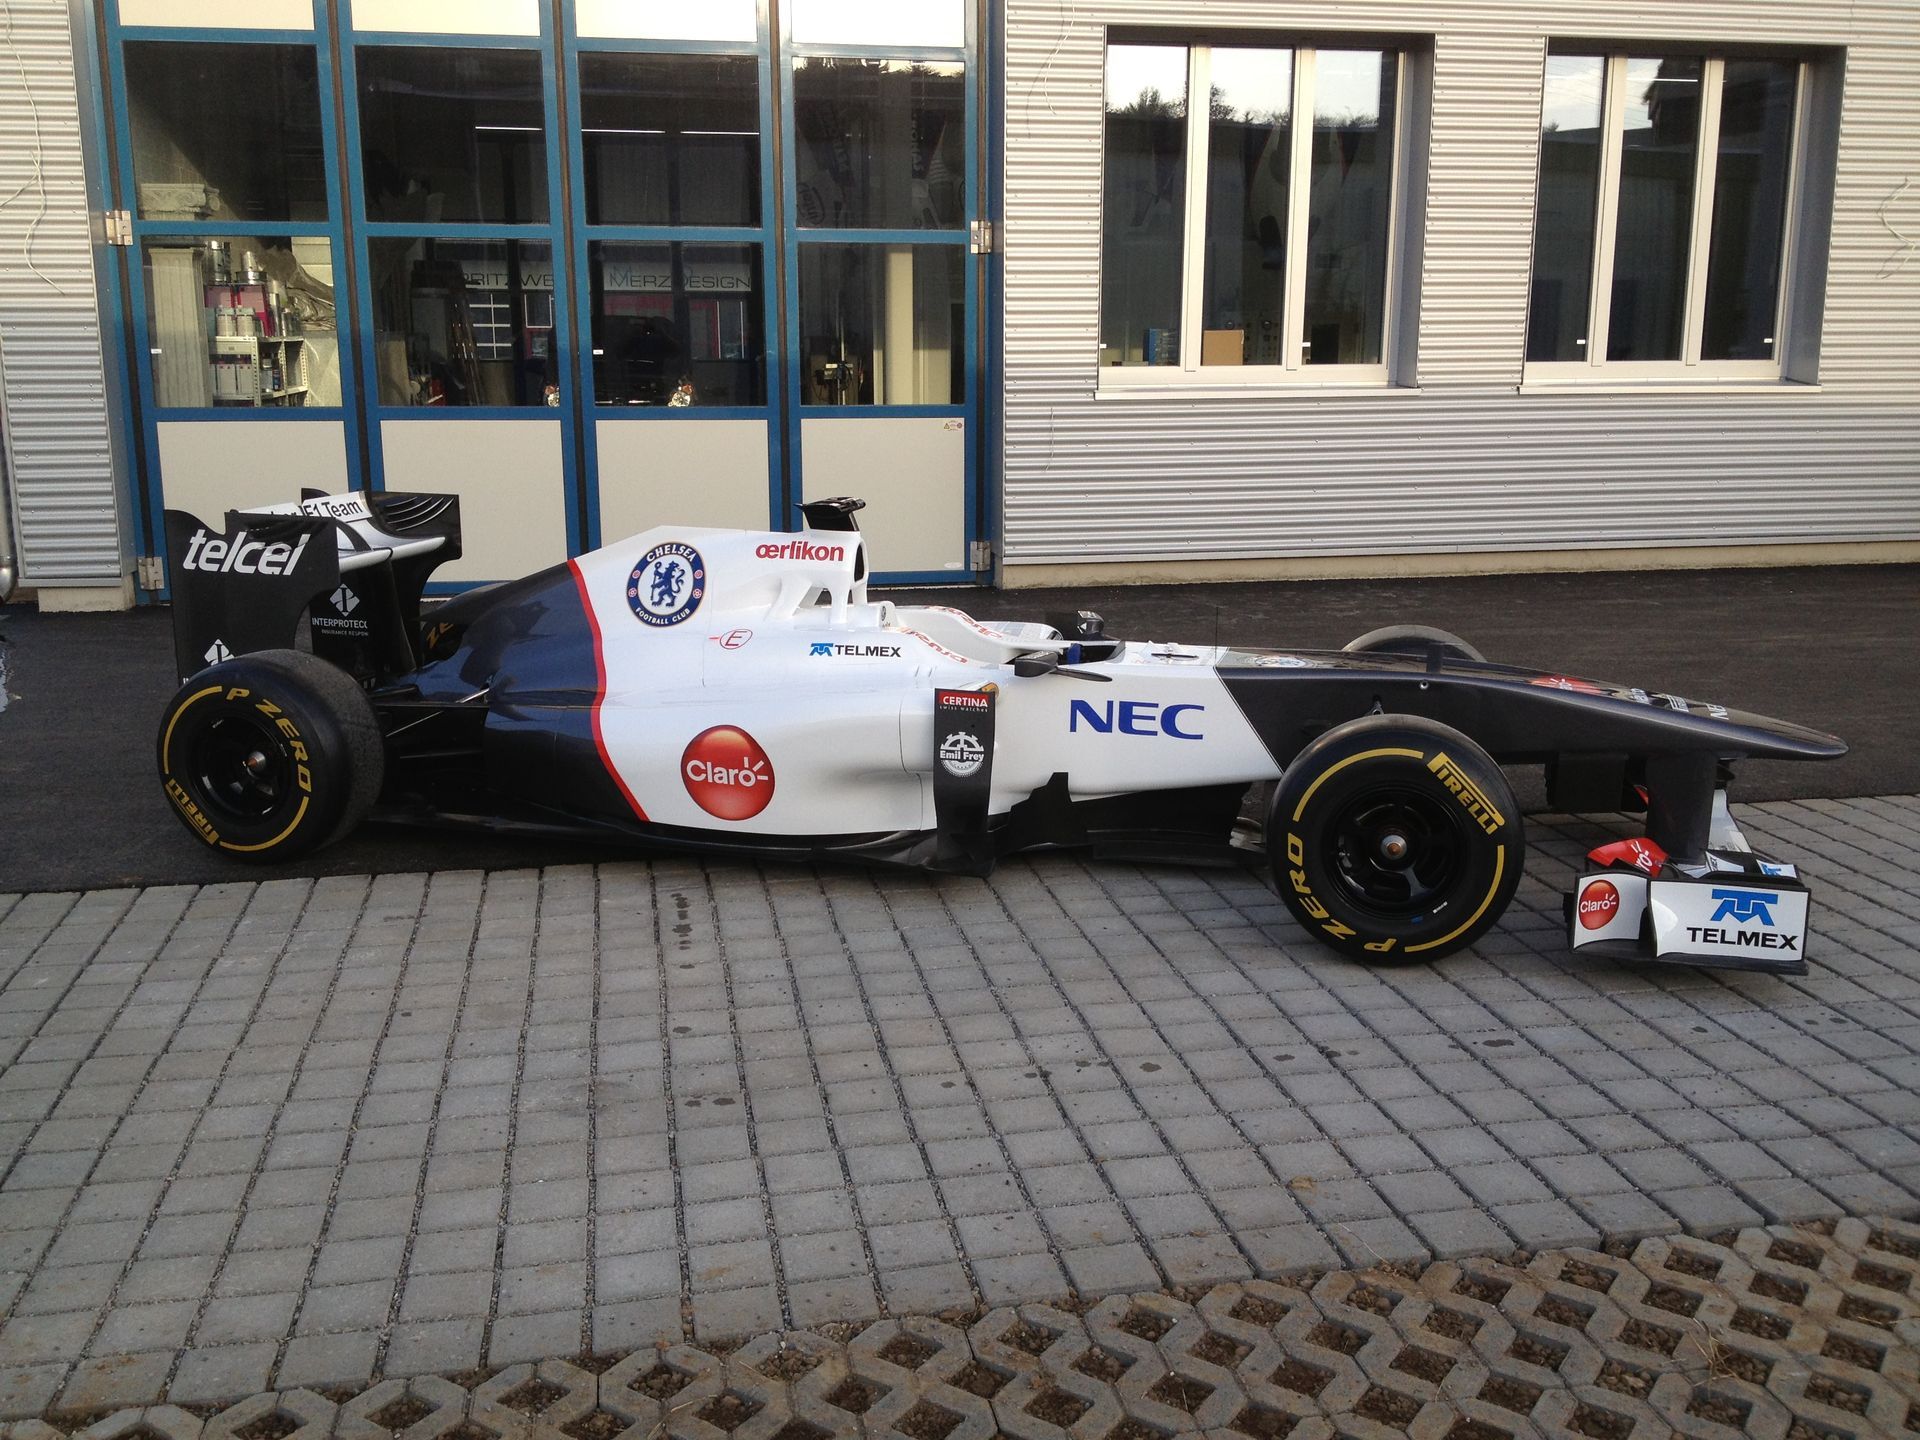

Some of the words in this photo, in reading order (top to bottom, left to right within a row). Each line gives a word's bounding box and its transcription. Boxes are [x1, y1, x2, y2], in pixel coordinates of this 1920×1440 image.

[321, 501, 363, 518] Team
[183, 529, 311, 576] telcel
[646, 544, 697, 562] CHELSEA
[635, 607, 668, 625] FOOTBALL
[672, 608, 691, 623] CLUB
[835, 644, 902, 658] TELMEX
[943, 696, 988, 708] CERTINA
[1070, 699, 1205, 740] NEC
[226, 688, 250, 700] P
[256, 699, 312, 792] ZERO
[940, 750, 960, 760] Emil
[963, 751, 985, 762] Frey
[686, 758, 760, 787] Claro
[1426, 752, 1505, 835] PIRELLI
[165, 778, 219, 845] PIRELLI
[1288, 832, 1356, 940] ZERO
[1580, 897, 1613, 913] Claro
[1364, 938, 1398, 952] P
[1687, 927, 1798, 950] TELMEX
